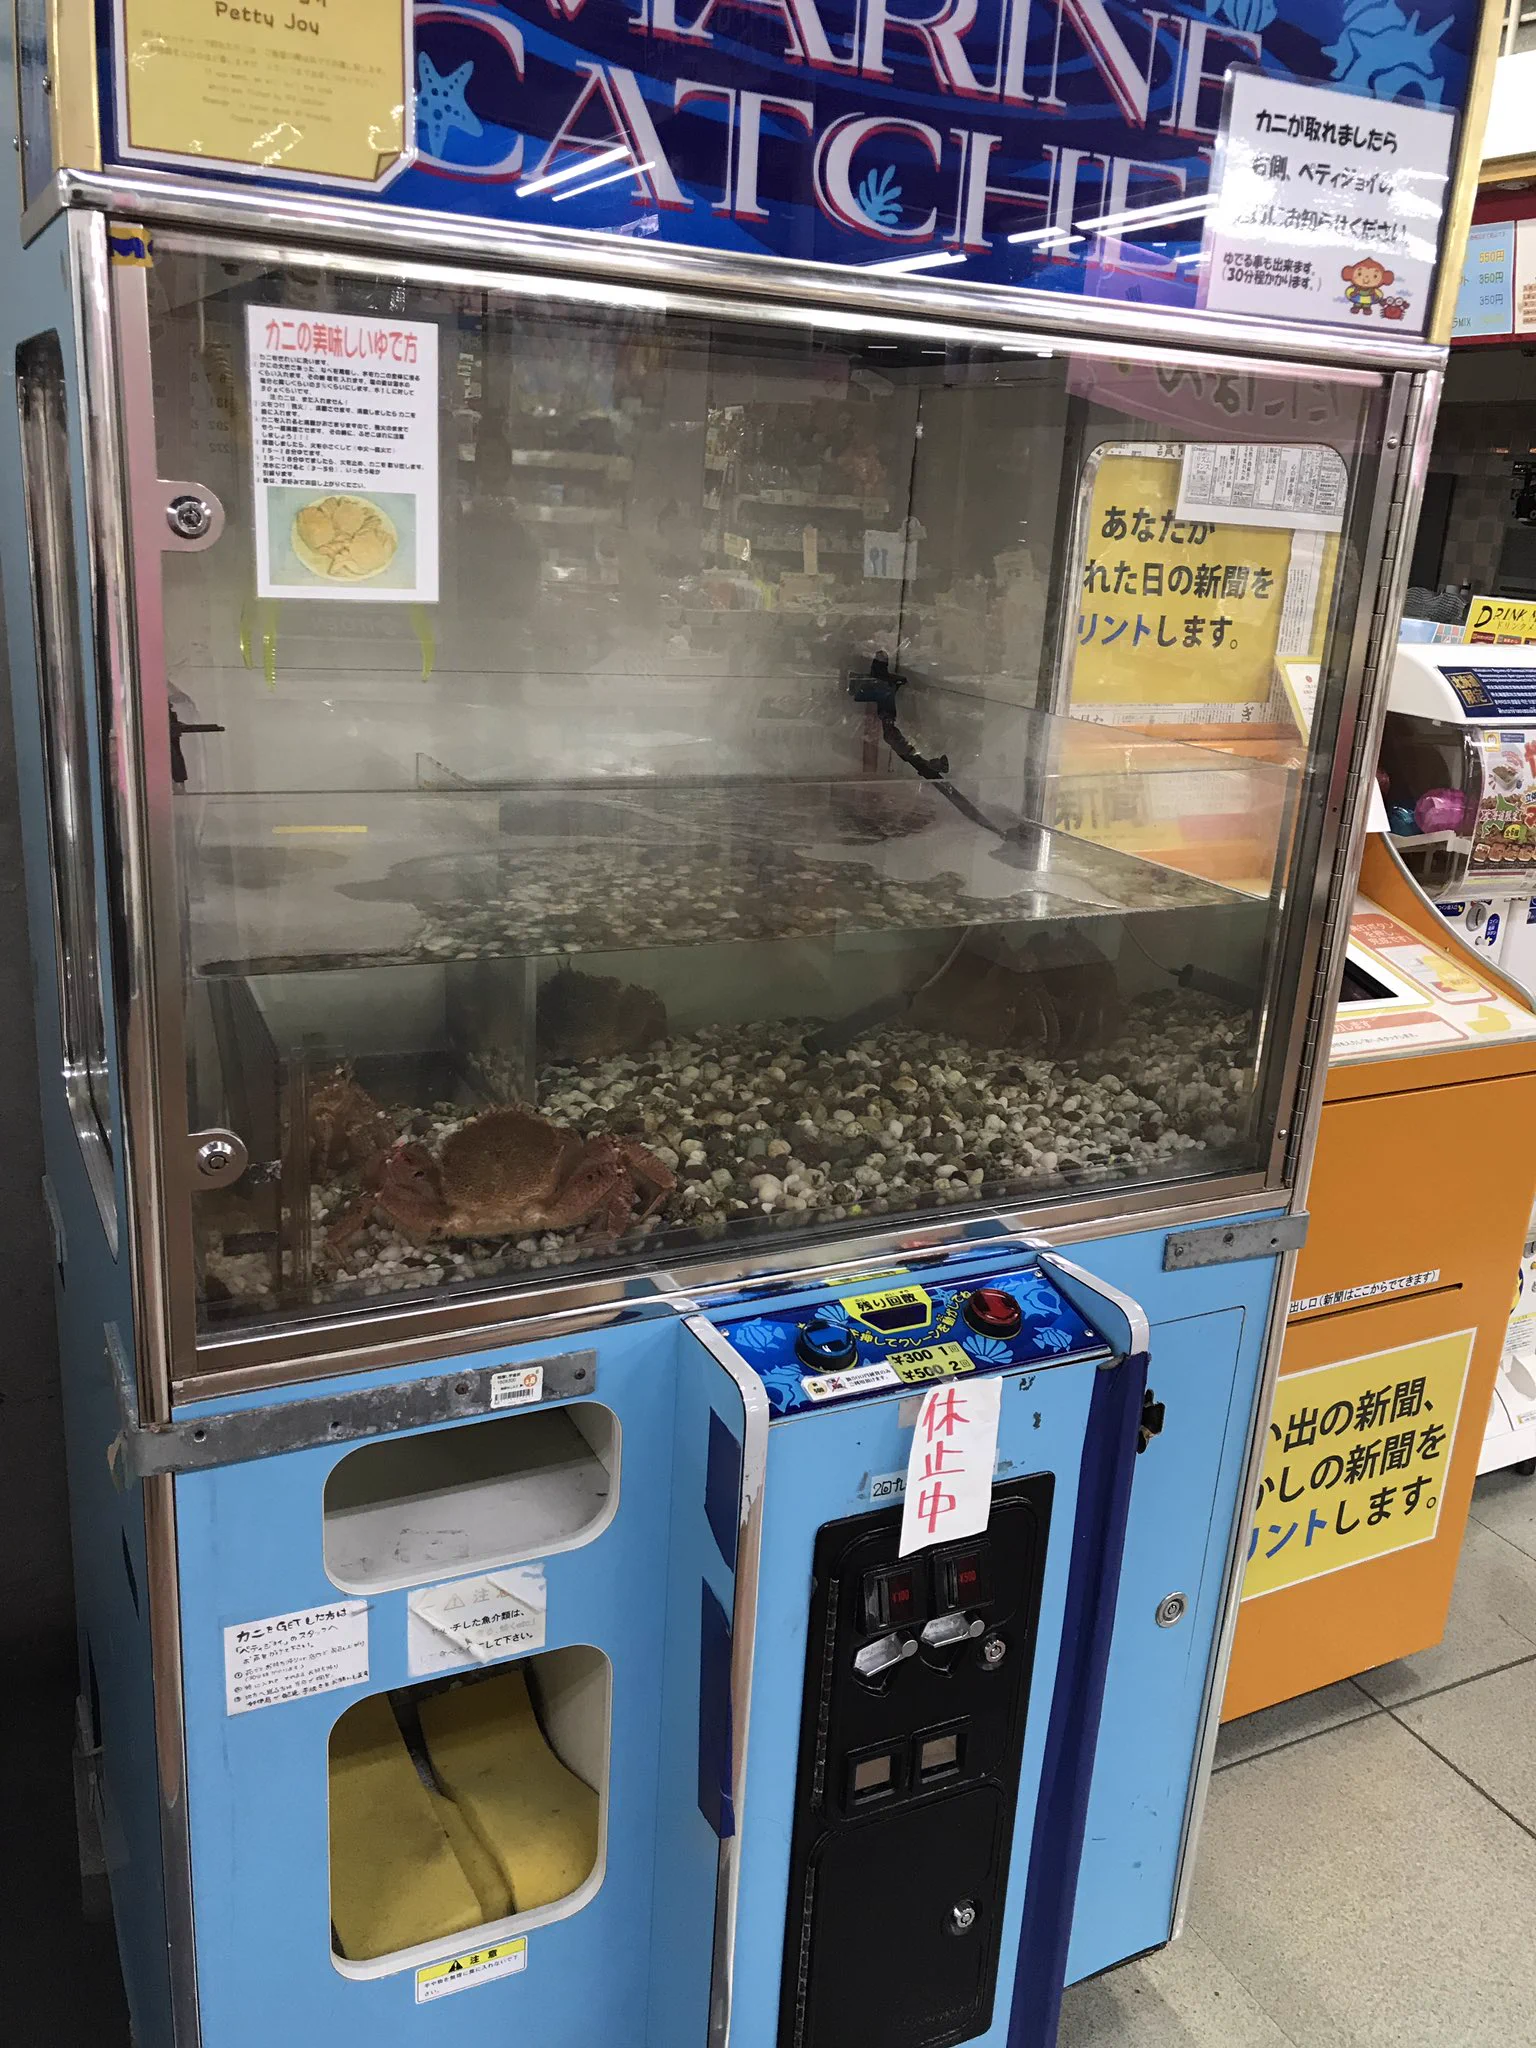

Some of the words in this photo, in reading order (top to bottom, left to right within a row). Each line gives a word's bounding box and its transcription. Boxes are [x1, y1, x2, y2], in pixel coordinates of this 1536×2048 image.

[215, 1, 274, 28] Petty
[284, 13, 320, 36] Joy
[412, 3, 1222, 285] CATCHE
[1255, 108, 1398, 155] カニが取れましたら
[1223, 252, 1315, 275] ゆでる事も出来ます。
[1478, 271, 1504, 285] 350円
[1479, 293, 1504, 306] 350円
[265, 318, 418, 364] カニの美味しいゆで方
[1083, 558, 1275, 600] れた日の新聞を
[1077, 613, 1239, 650] リントします。
[856, 1293, 919, 1313] 残り回数
[891, 1349, 933, 1366] ¥300
[937, 1345, 960, 1356] 1回
[902, 1364, 944, 1381] ¥500
[948, 1358, 971, 1371] 2回
[1269, 1376, 1434, 1453] 出の新聞、
[916, 1387, 971, 1534] 休止中
[236, 1608, 347, 1643] カニをGETした方は
